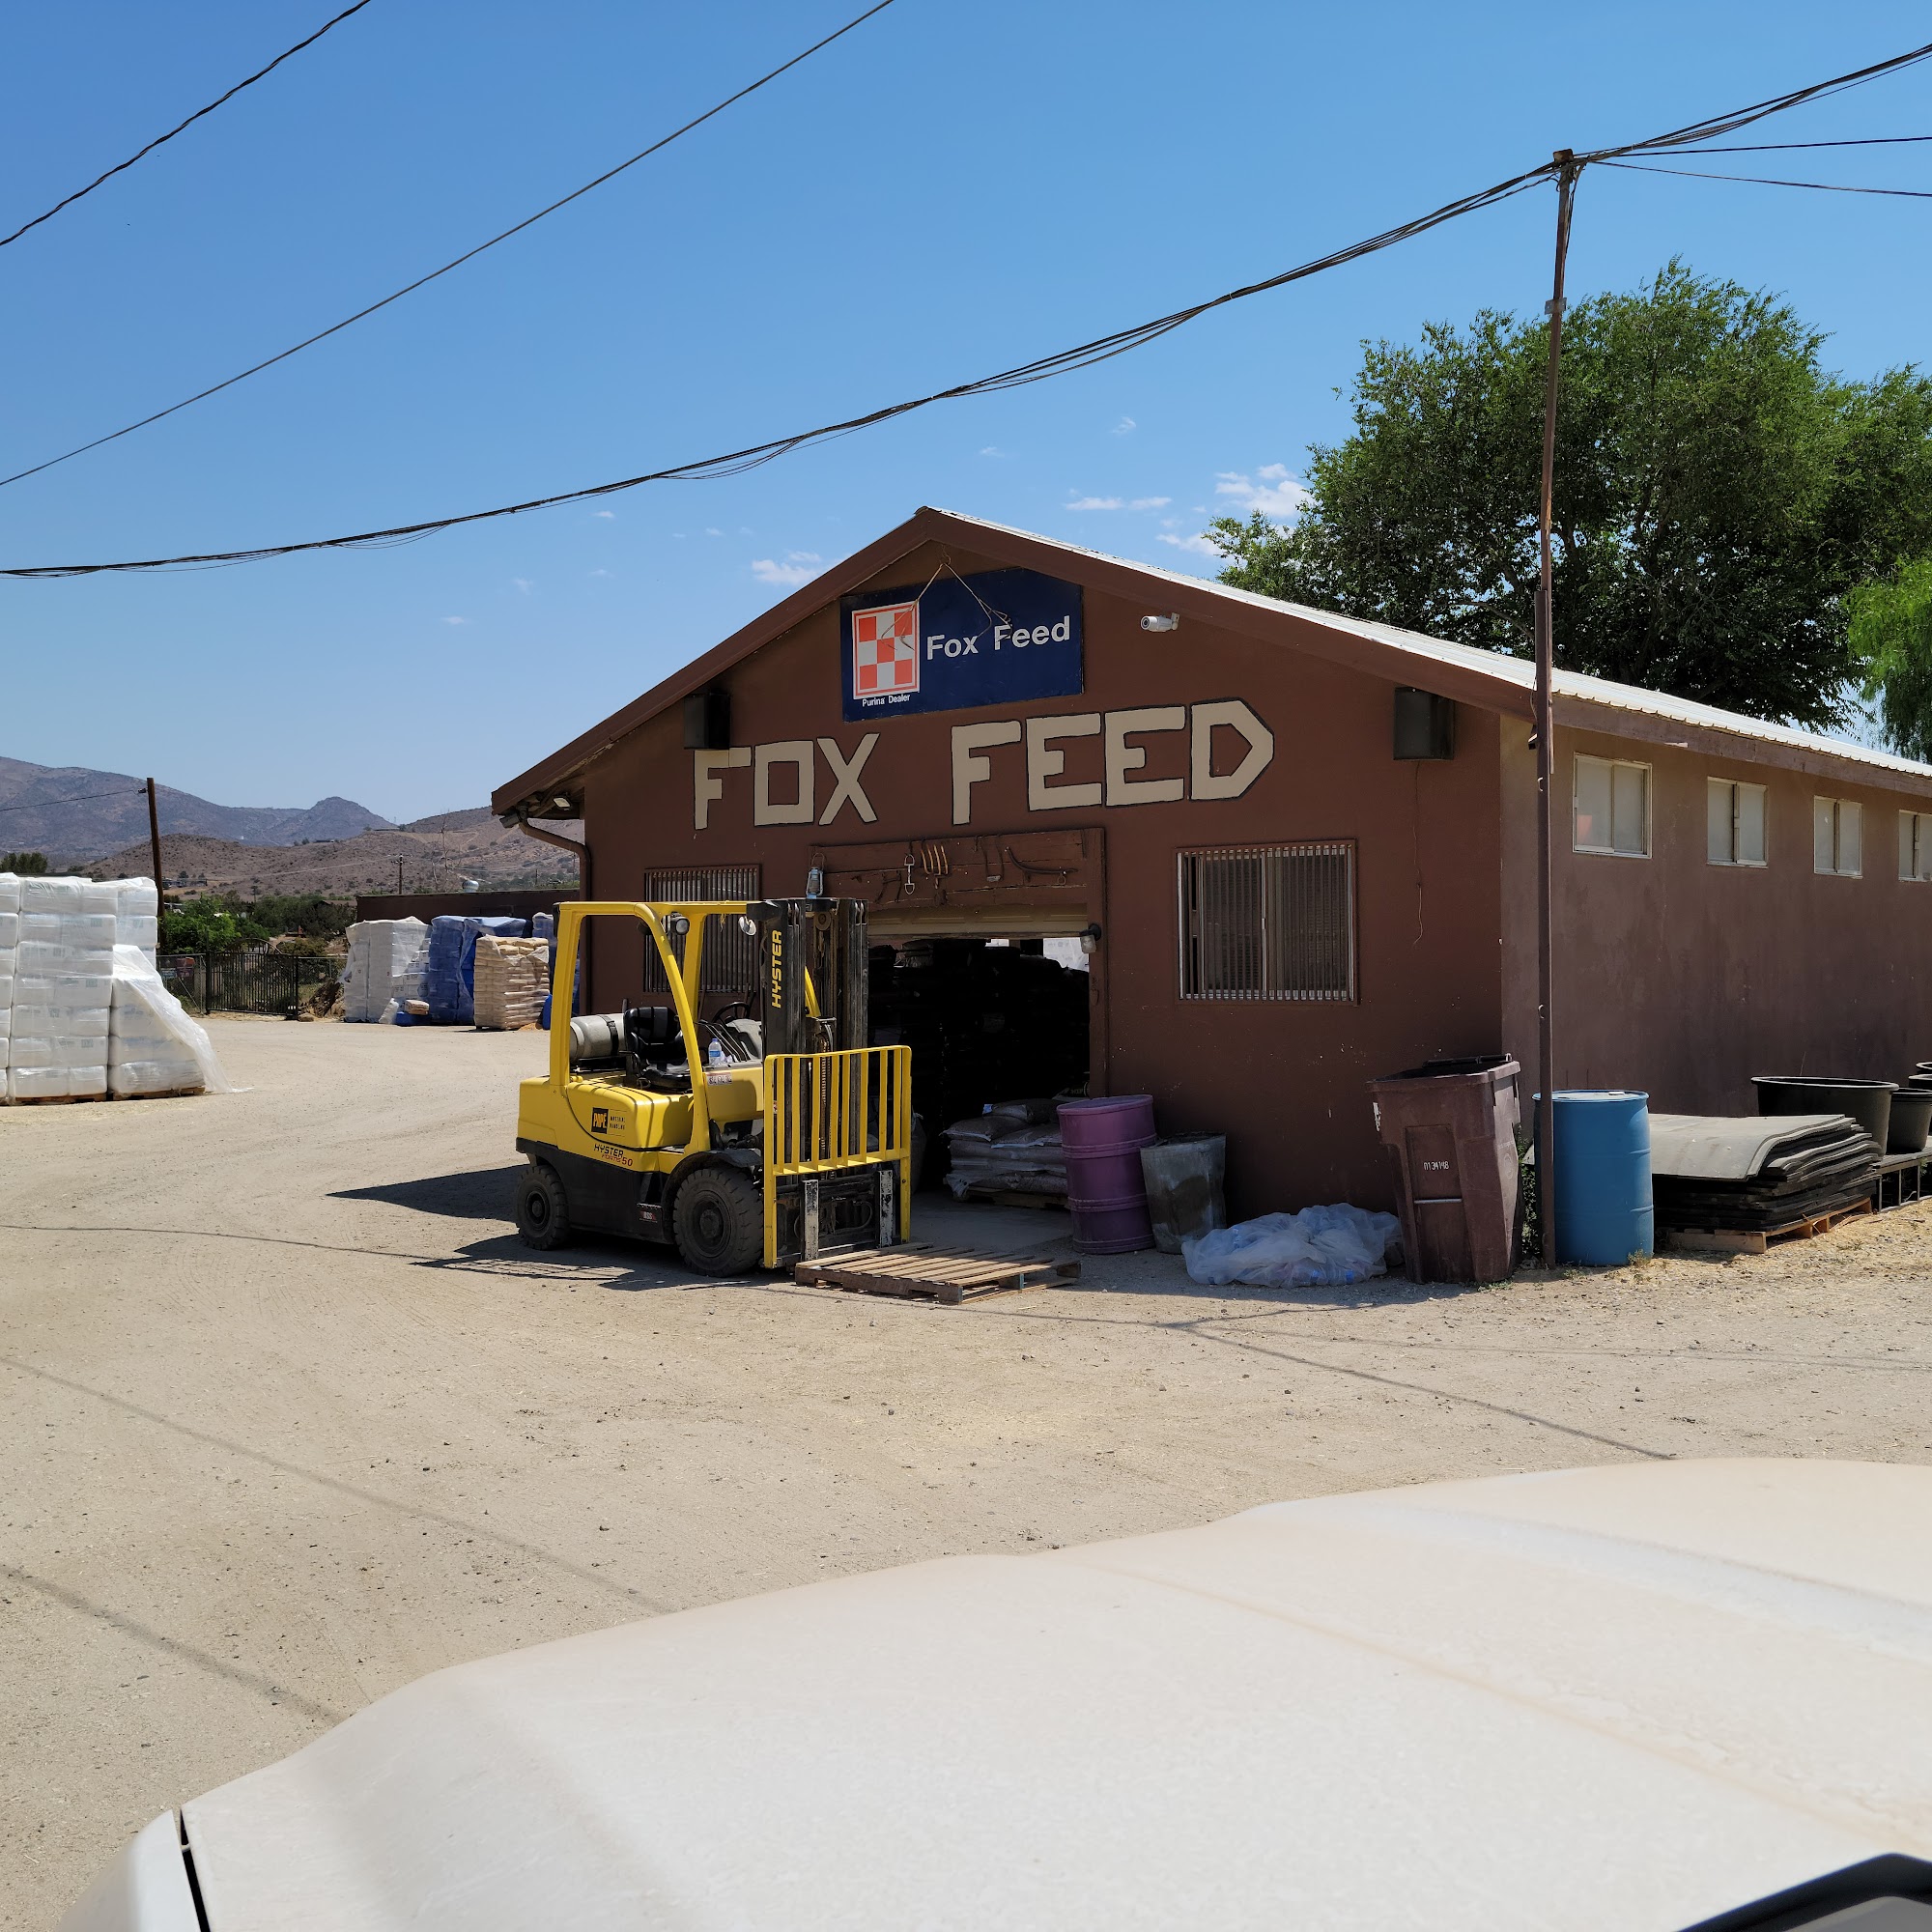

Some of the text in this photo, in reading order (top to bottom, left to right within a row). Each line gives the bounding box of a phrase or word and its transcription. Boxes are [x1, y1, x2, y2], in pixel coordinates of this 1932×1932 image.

[926, 614, 1070, 661] Fox Feed
[862, 694, 911, 707] Purina Dealer
[694, 697, 1275, 831] FOX FEED
[771, 929, 782, 1009] HYSTER
[593, 1144, 624, 1158] HYSTER
[621, 1156, 634, 1167] 50
